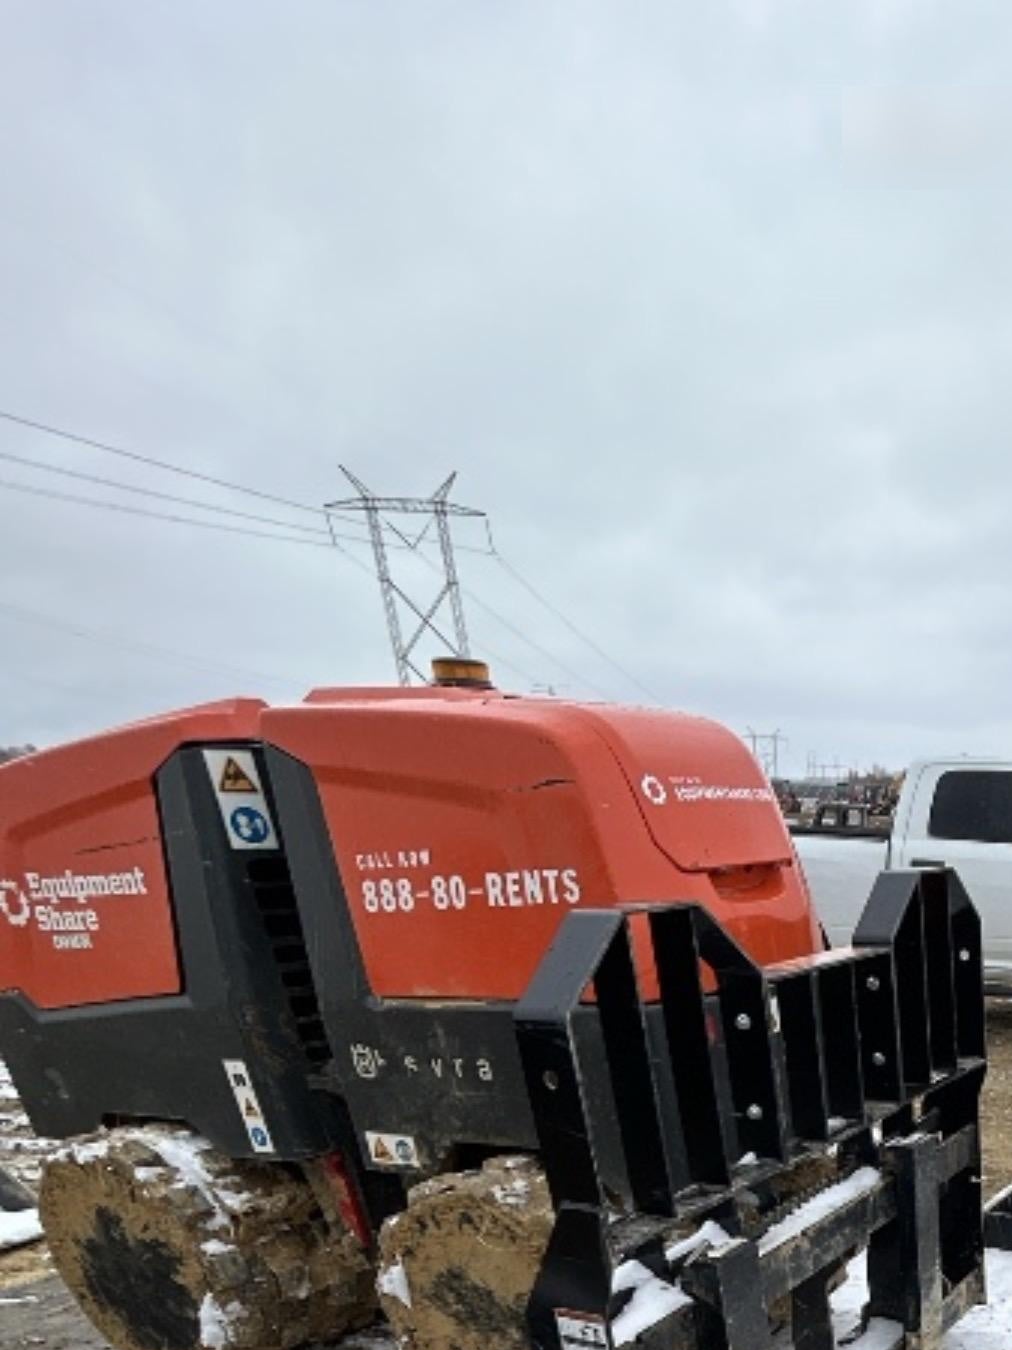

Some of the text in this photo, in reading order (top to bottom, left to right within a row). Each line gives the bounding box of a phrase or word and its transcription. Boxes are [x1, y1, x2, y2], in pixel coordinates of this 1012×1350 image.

[25, 866, 147, 903] Equipment
[361, 869, 580, 913] 888-80-RENTS
[35, 904, 99, 931] Share
